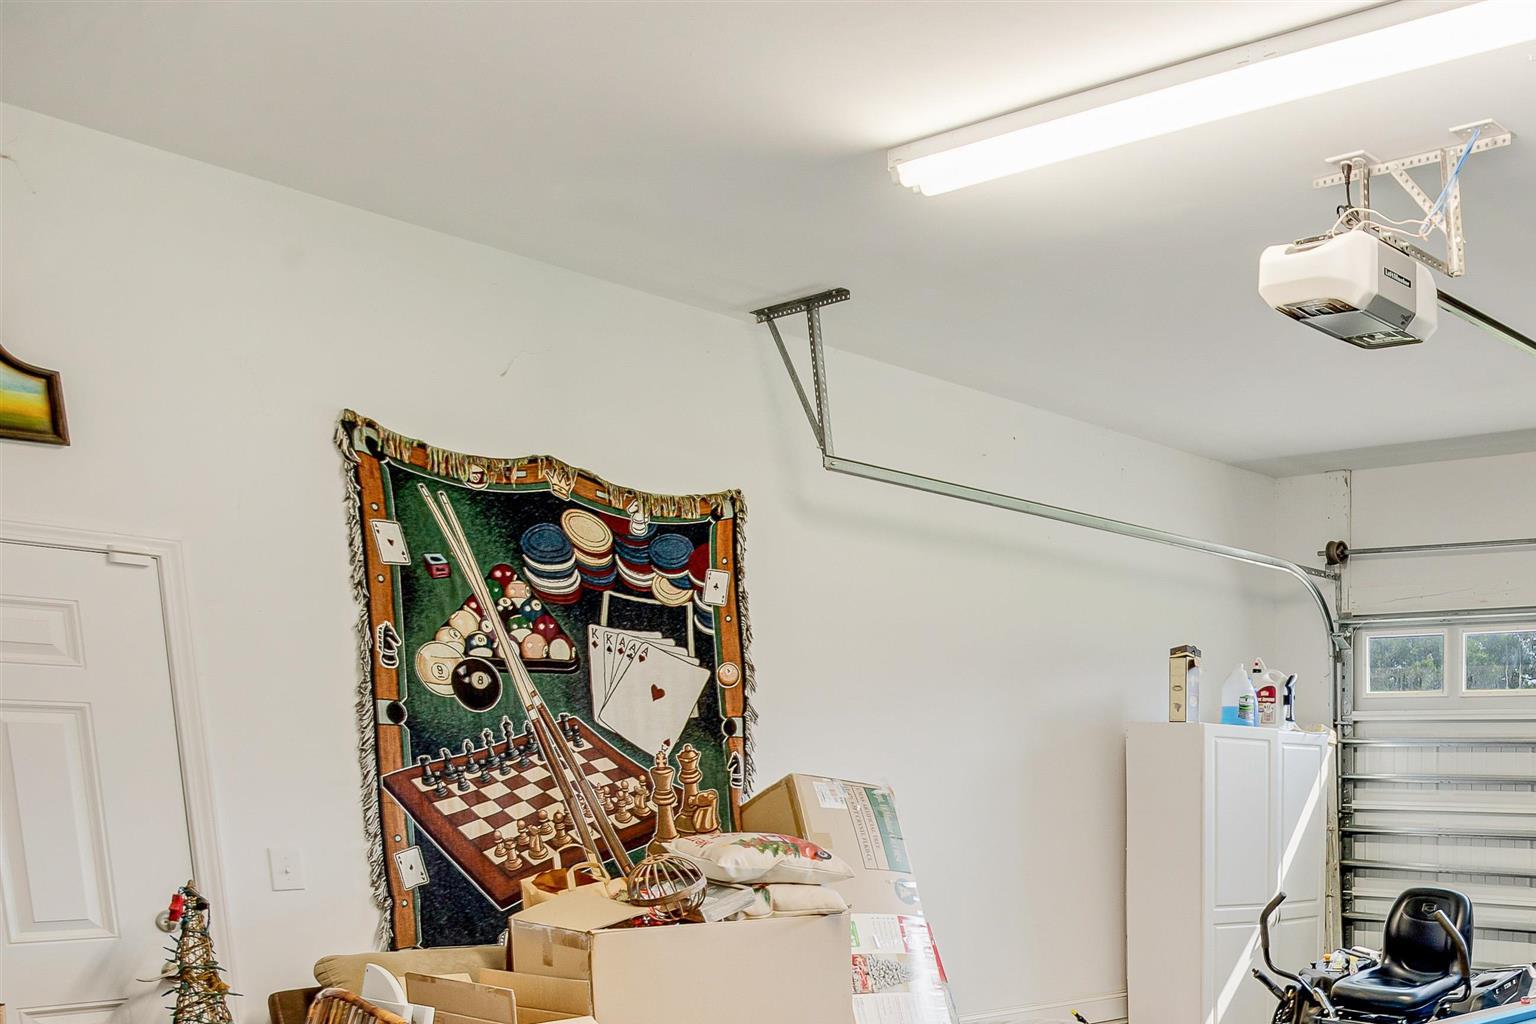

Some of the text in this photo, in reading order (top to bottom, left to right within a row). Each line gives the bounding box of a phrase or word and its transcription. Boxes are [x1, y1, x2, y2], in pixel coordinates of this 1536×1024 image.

[591, 628, 599, 639] K
[606, 634, 612, 645] K
[619, 637, 625, 647] A
[629, 644, 636, 653] A
[641, 647, 649, 657] A
[477, 675, 484, 685] 8
